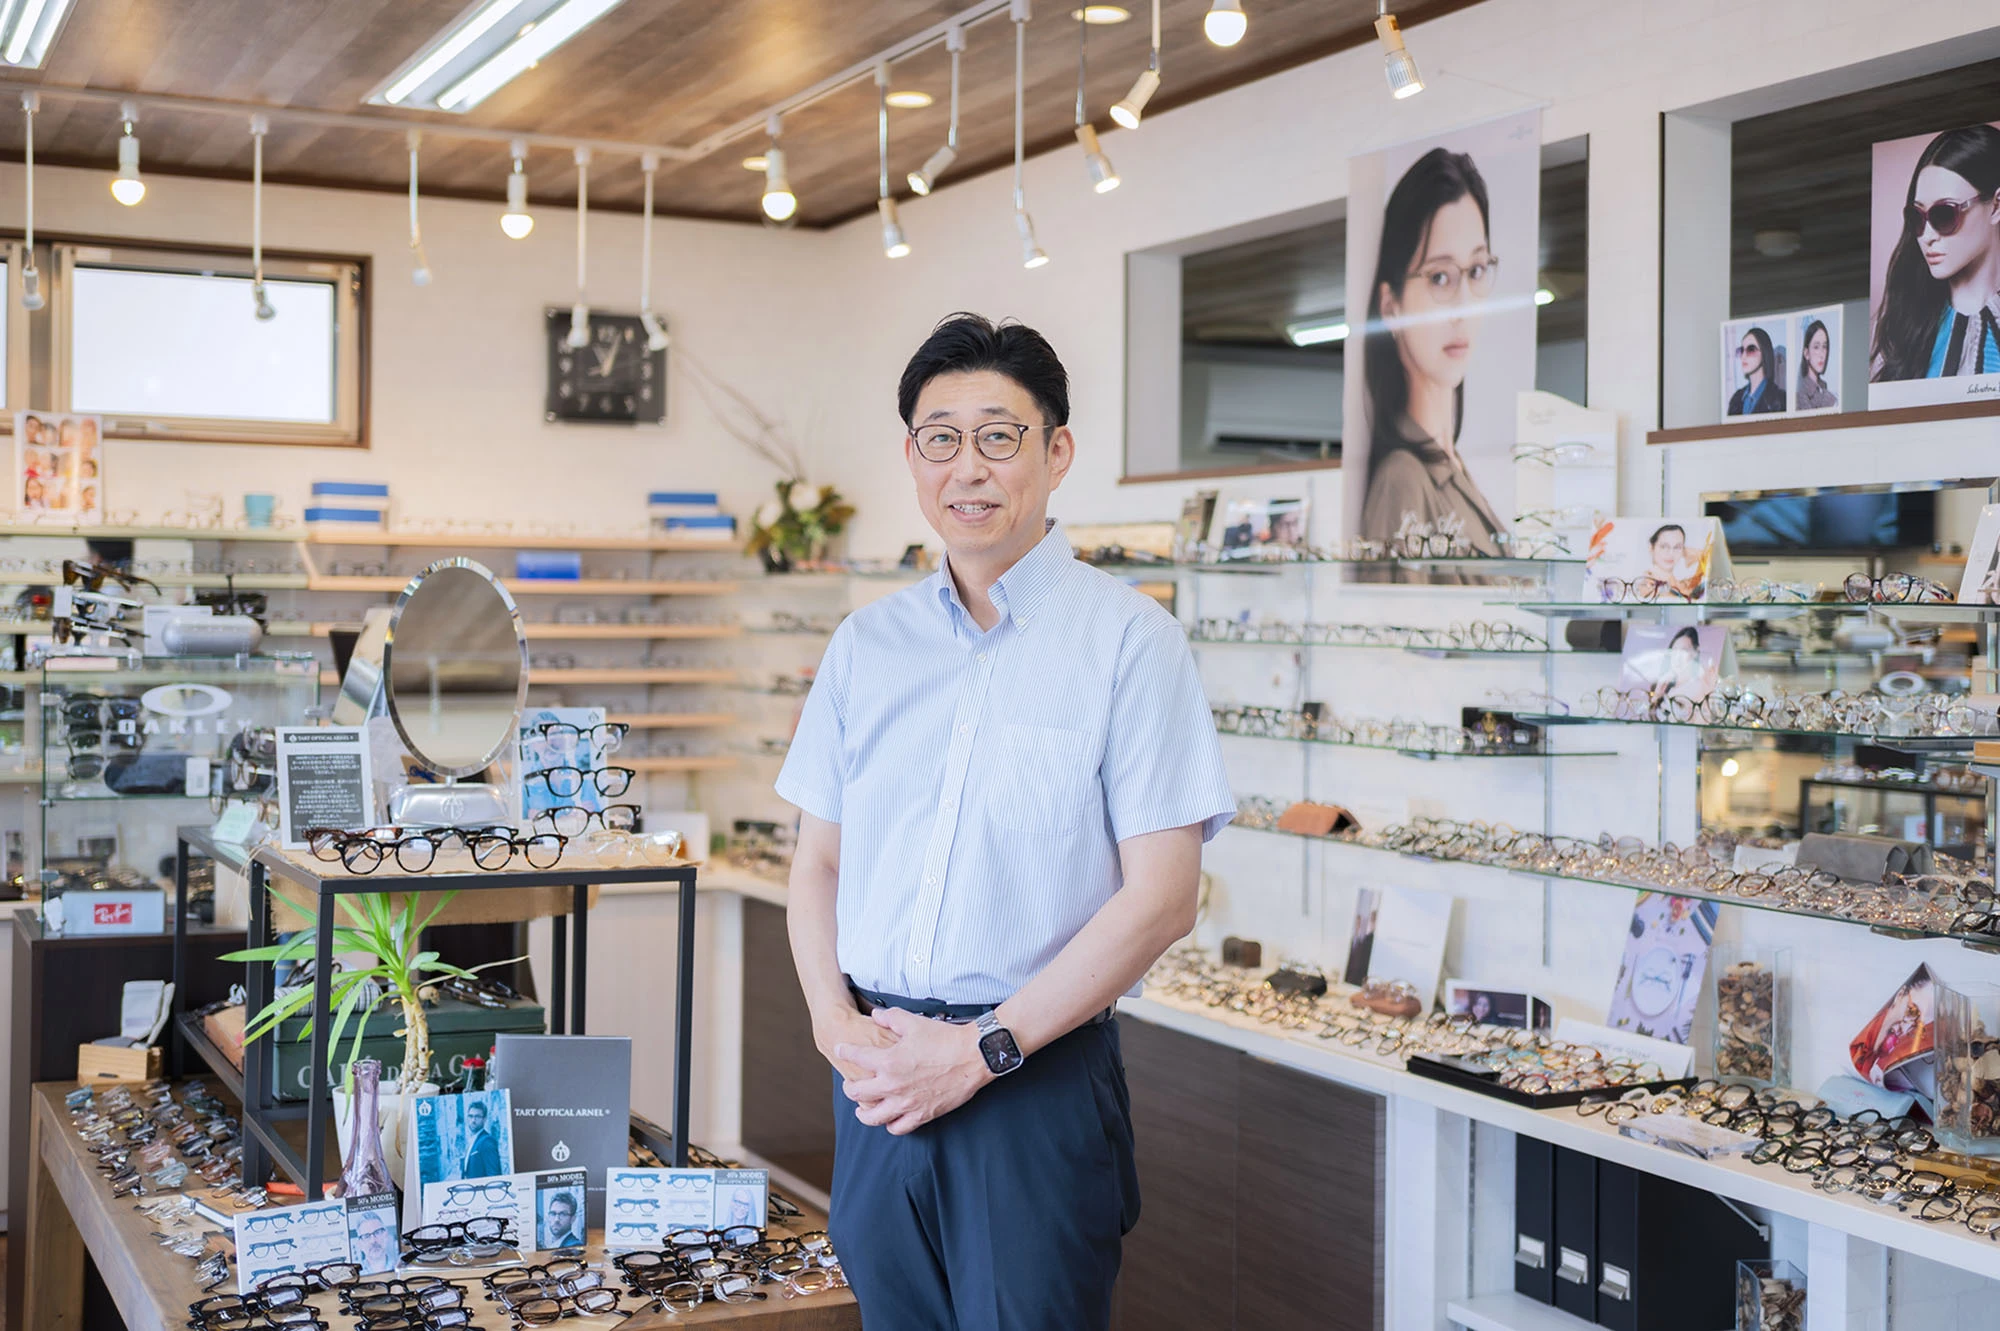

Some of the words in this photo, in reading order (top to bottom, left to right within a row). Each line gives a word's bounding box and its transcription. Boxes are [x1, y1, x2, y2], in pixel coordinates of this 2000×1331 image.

[118, 719, 252, 735] OAKLEY
[514, 1108, 536, 1117] TART
[537, 1108, 574, 1117] OPTICAL
[575, 1108, 604, 1117] ARNEL
[559, 1172, 585, 1182] MODEL
[369, 1193, 395, 1203] MODEL
